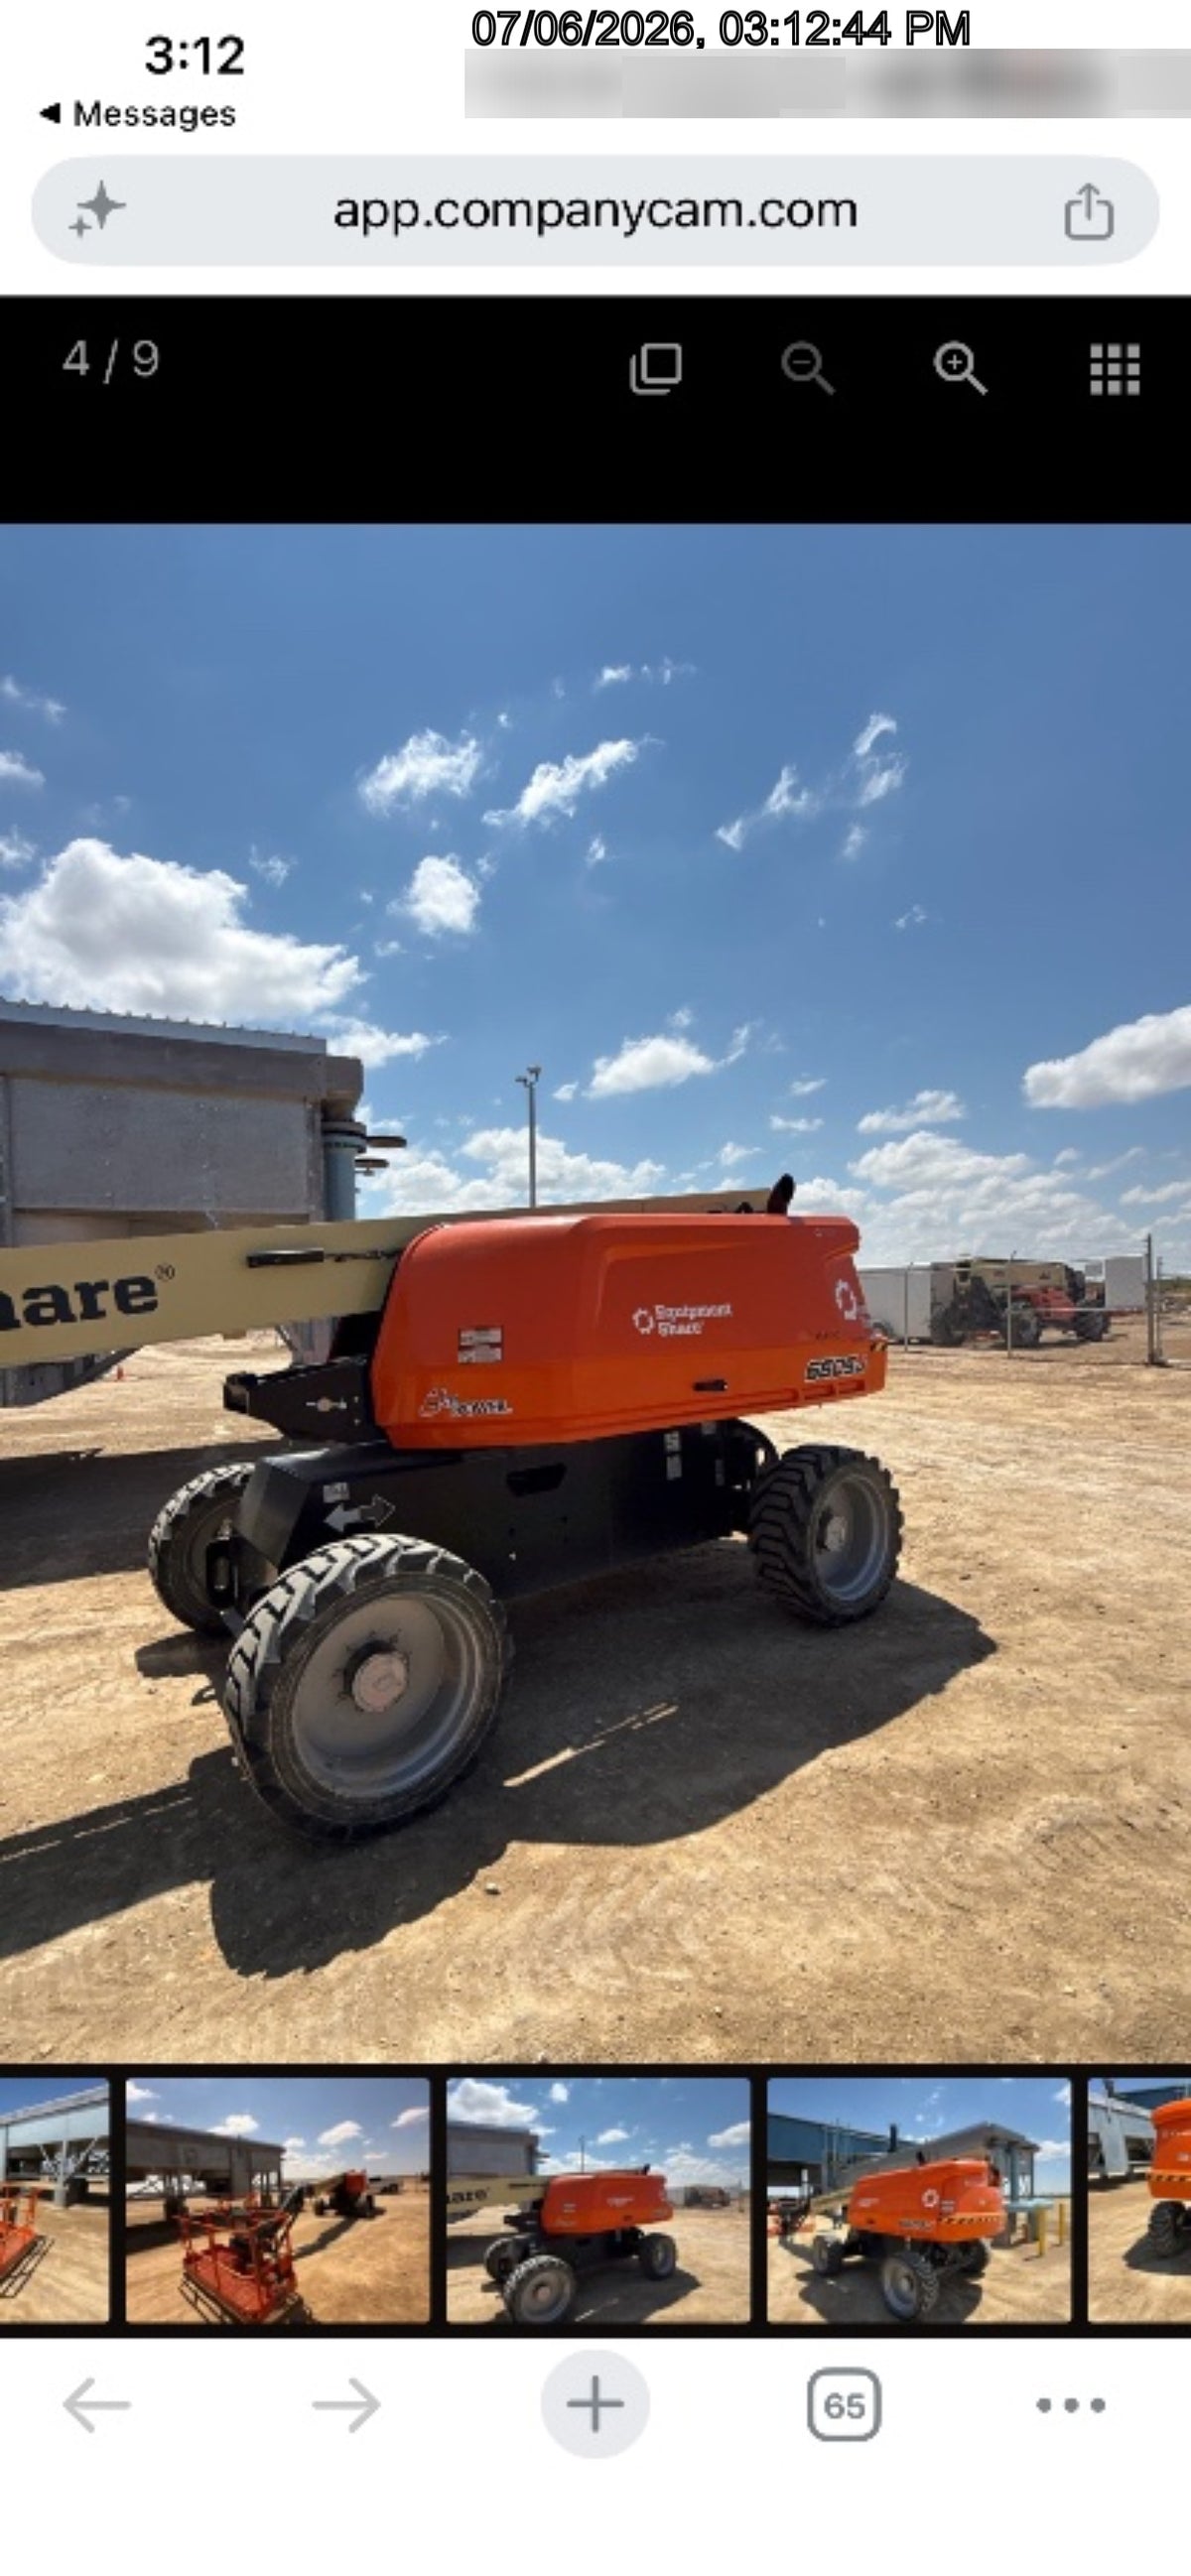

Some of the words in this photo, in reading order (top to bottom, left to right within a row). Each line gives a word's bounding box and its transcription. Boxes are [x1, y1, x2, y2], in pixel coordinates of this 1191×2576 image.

[146, 35, 245, 75] 3:12
[74, 100, 236, 133] Messages
[333, 198, 858, 238] app.companycam.com
[63, 339, 90, 376] 4
[133, 339, 159, 377] 9
[824, 2392, 865, 2419] 65
